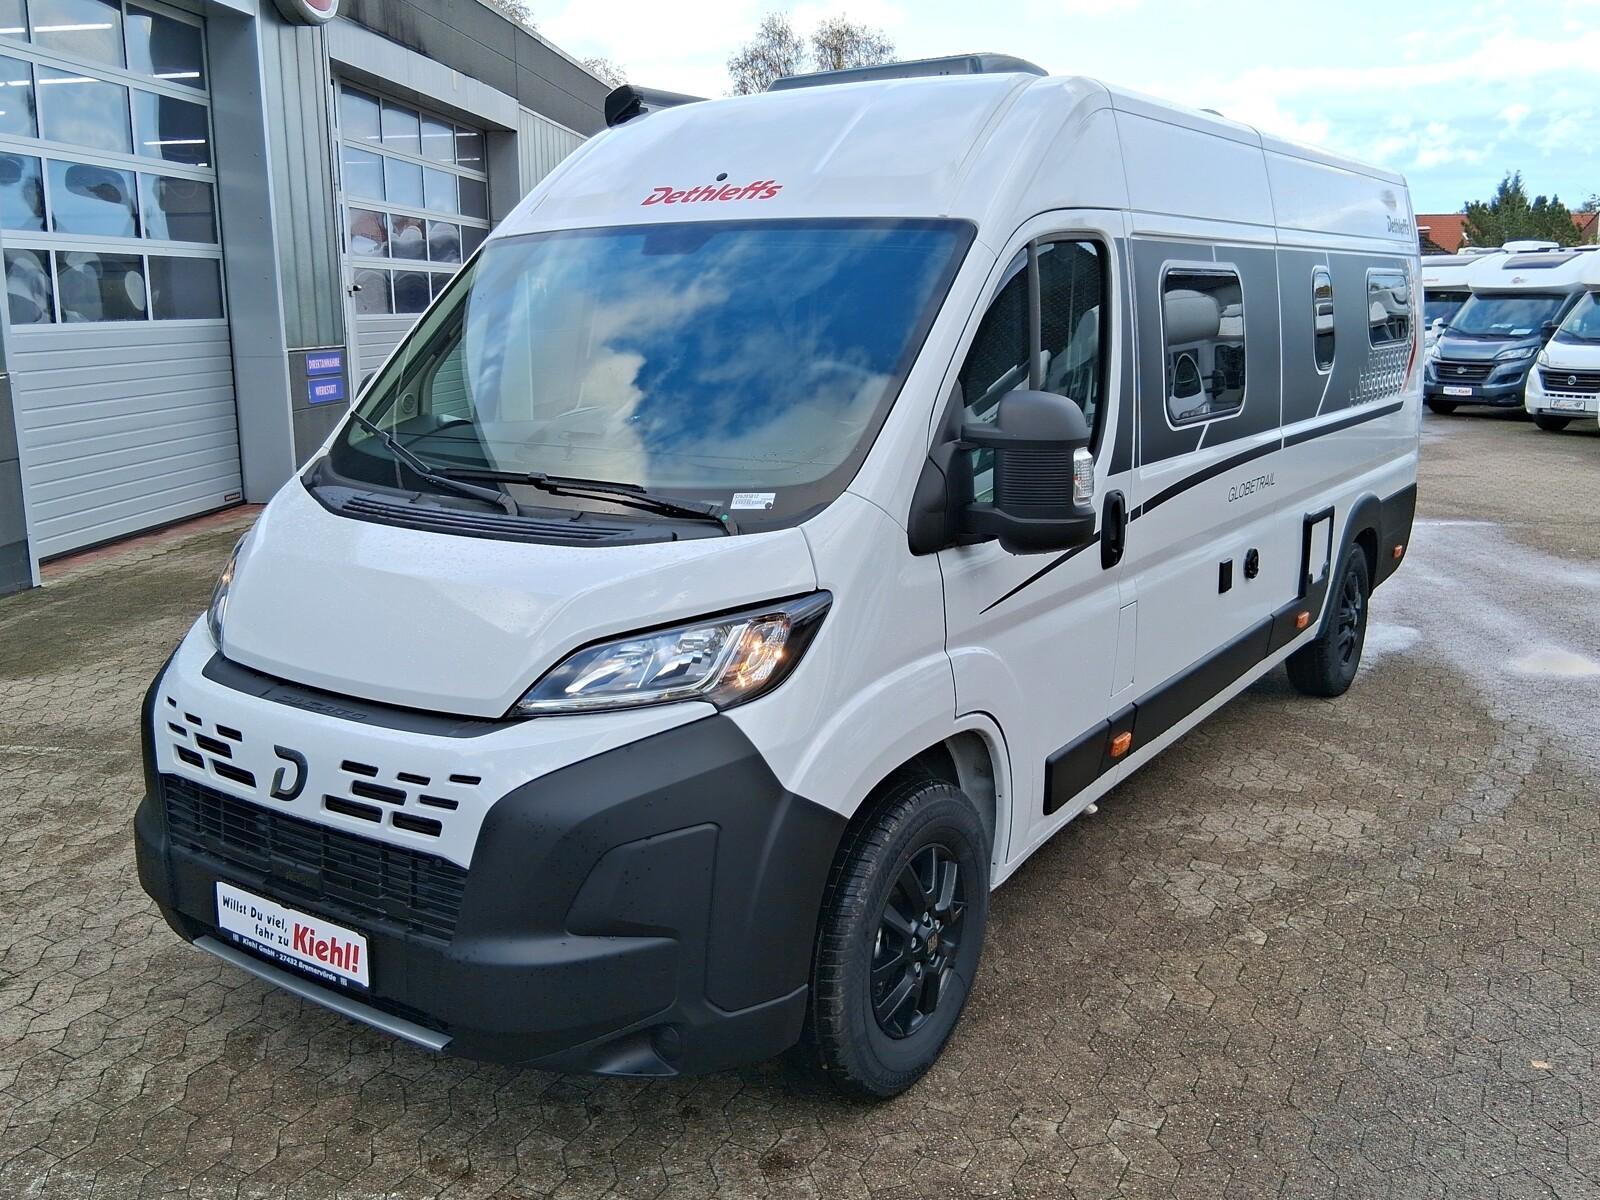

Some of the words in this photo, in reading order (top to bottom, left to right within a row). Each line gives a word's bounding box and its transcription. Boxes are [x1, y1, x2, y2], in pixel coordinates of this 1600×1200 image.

[640, 180, 783, 206] Dethleffs
[1228, 472, 1275, 502] GLOBETRAIL
[222, 895, 247, 915] Willst
[250, 906, 263, 921] Du
[266, 914, 288, 933] viel,
[242, 938, 258, 949] Kiehl
[258, 945, 275, 957] GmbH
[279, 953, 298, 967] 27432
[255, 923, 274, 941] fahr
[278, 935, 290, 947] zu
[294, 923, 360, 973] Kiehl!
